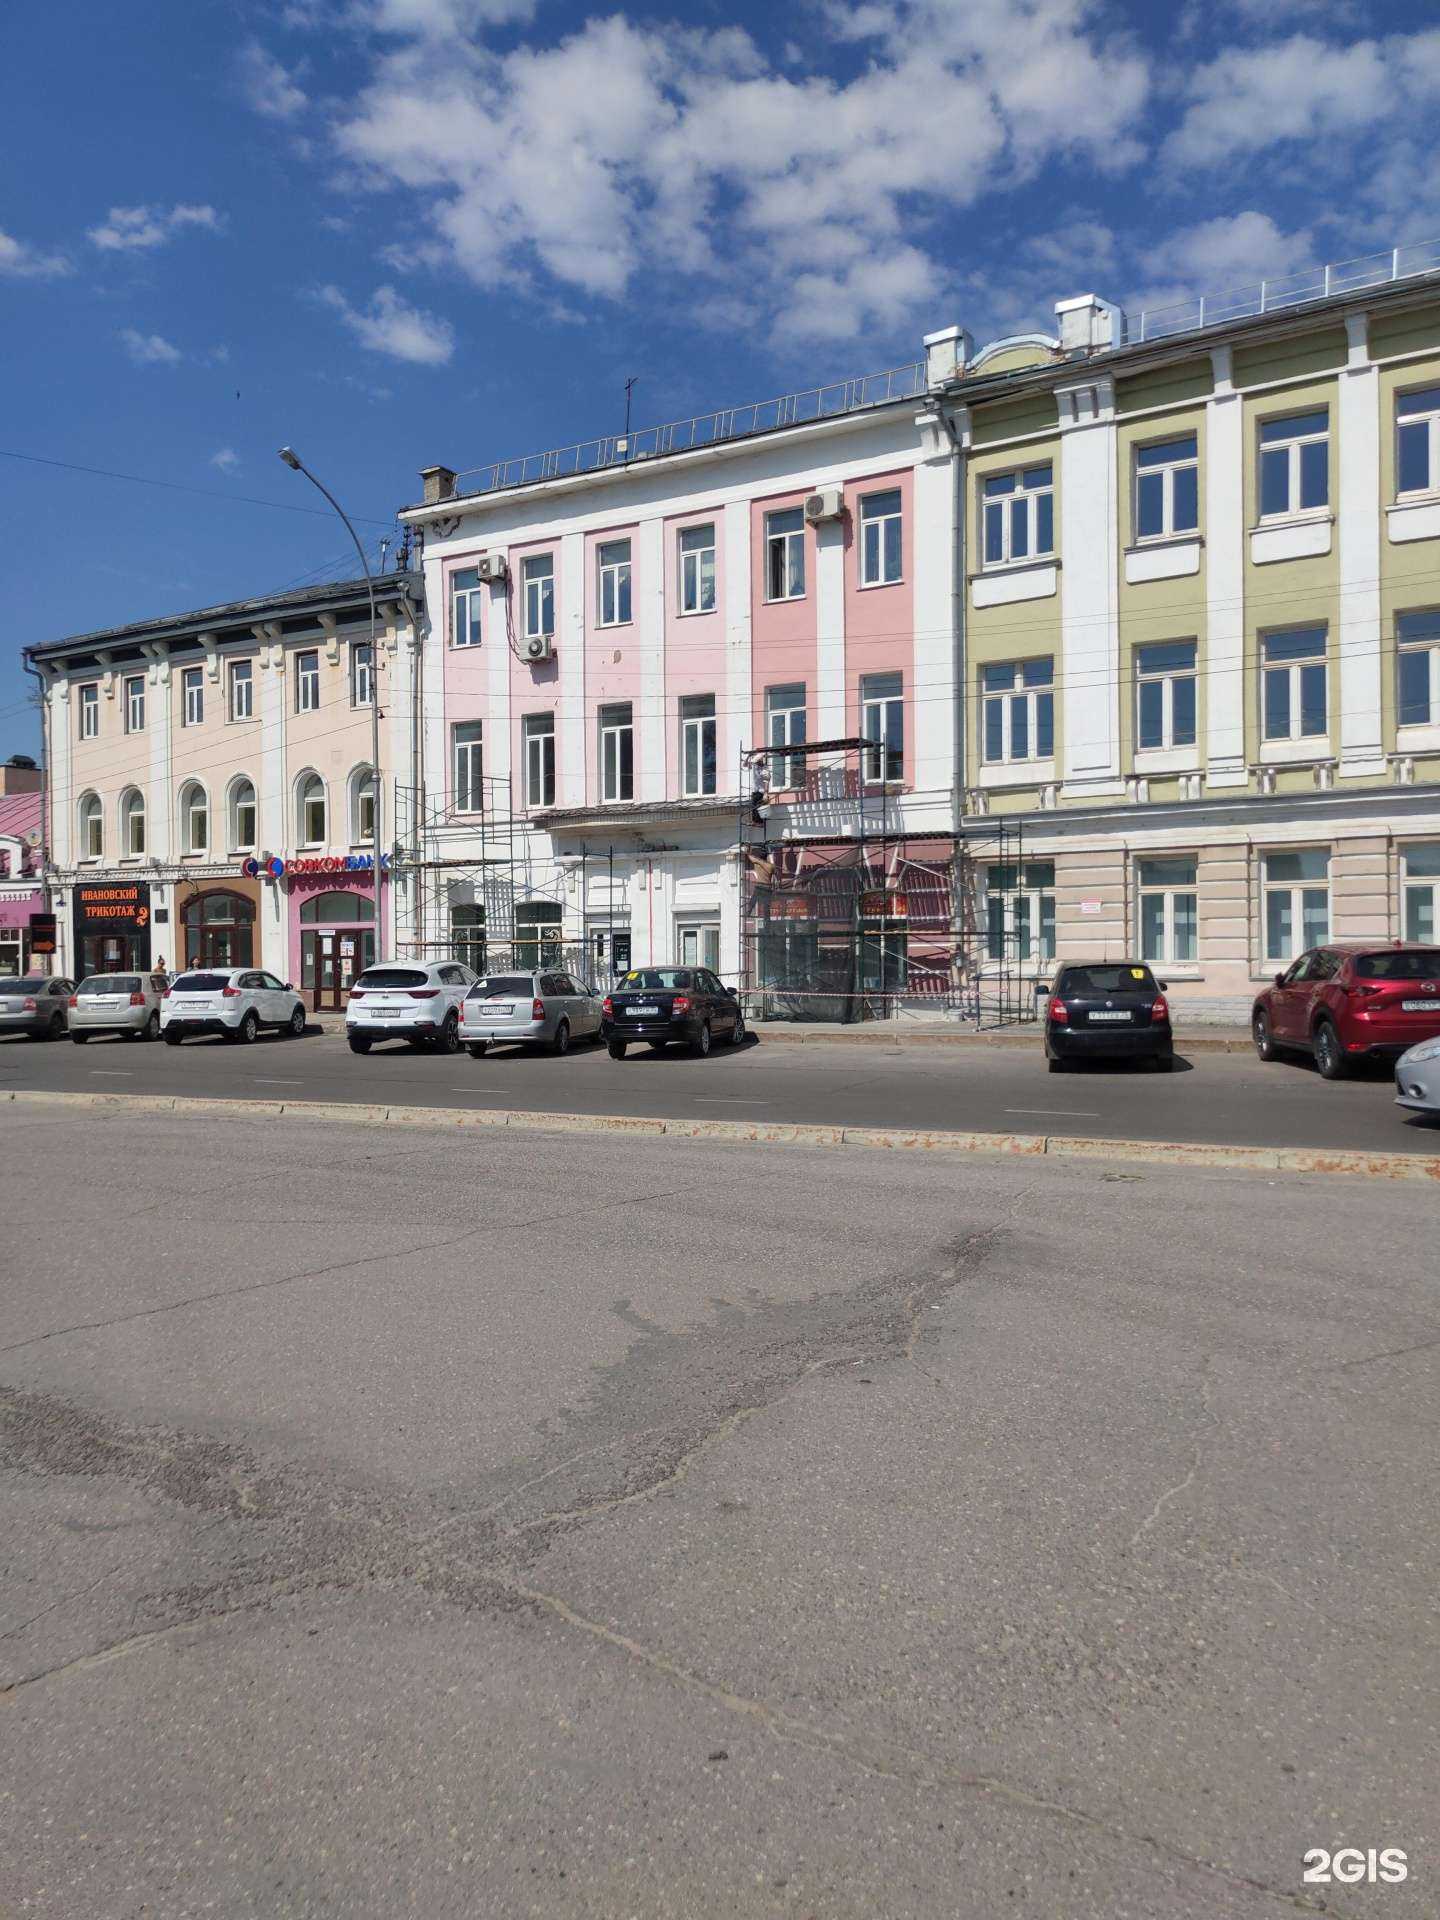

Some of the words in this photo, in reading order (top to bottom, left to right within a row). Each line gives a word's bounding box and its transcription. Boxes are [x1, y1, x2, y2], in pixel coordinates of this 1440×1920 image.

[285, 853, 390, 873] СОВКОМБАНК
[81, 886, 138, 901] ИВАНОВСКИЙ
[85, 905, 136, 917] ТРИКОТАЖ
